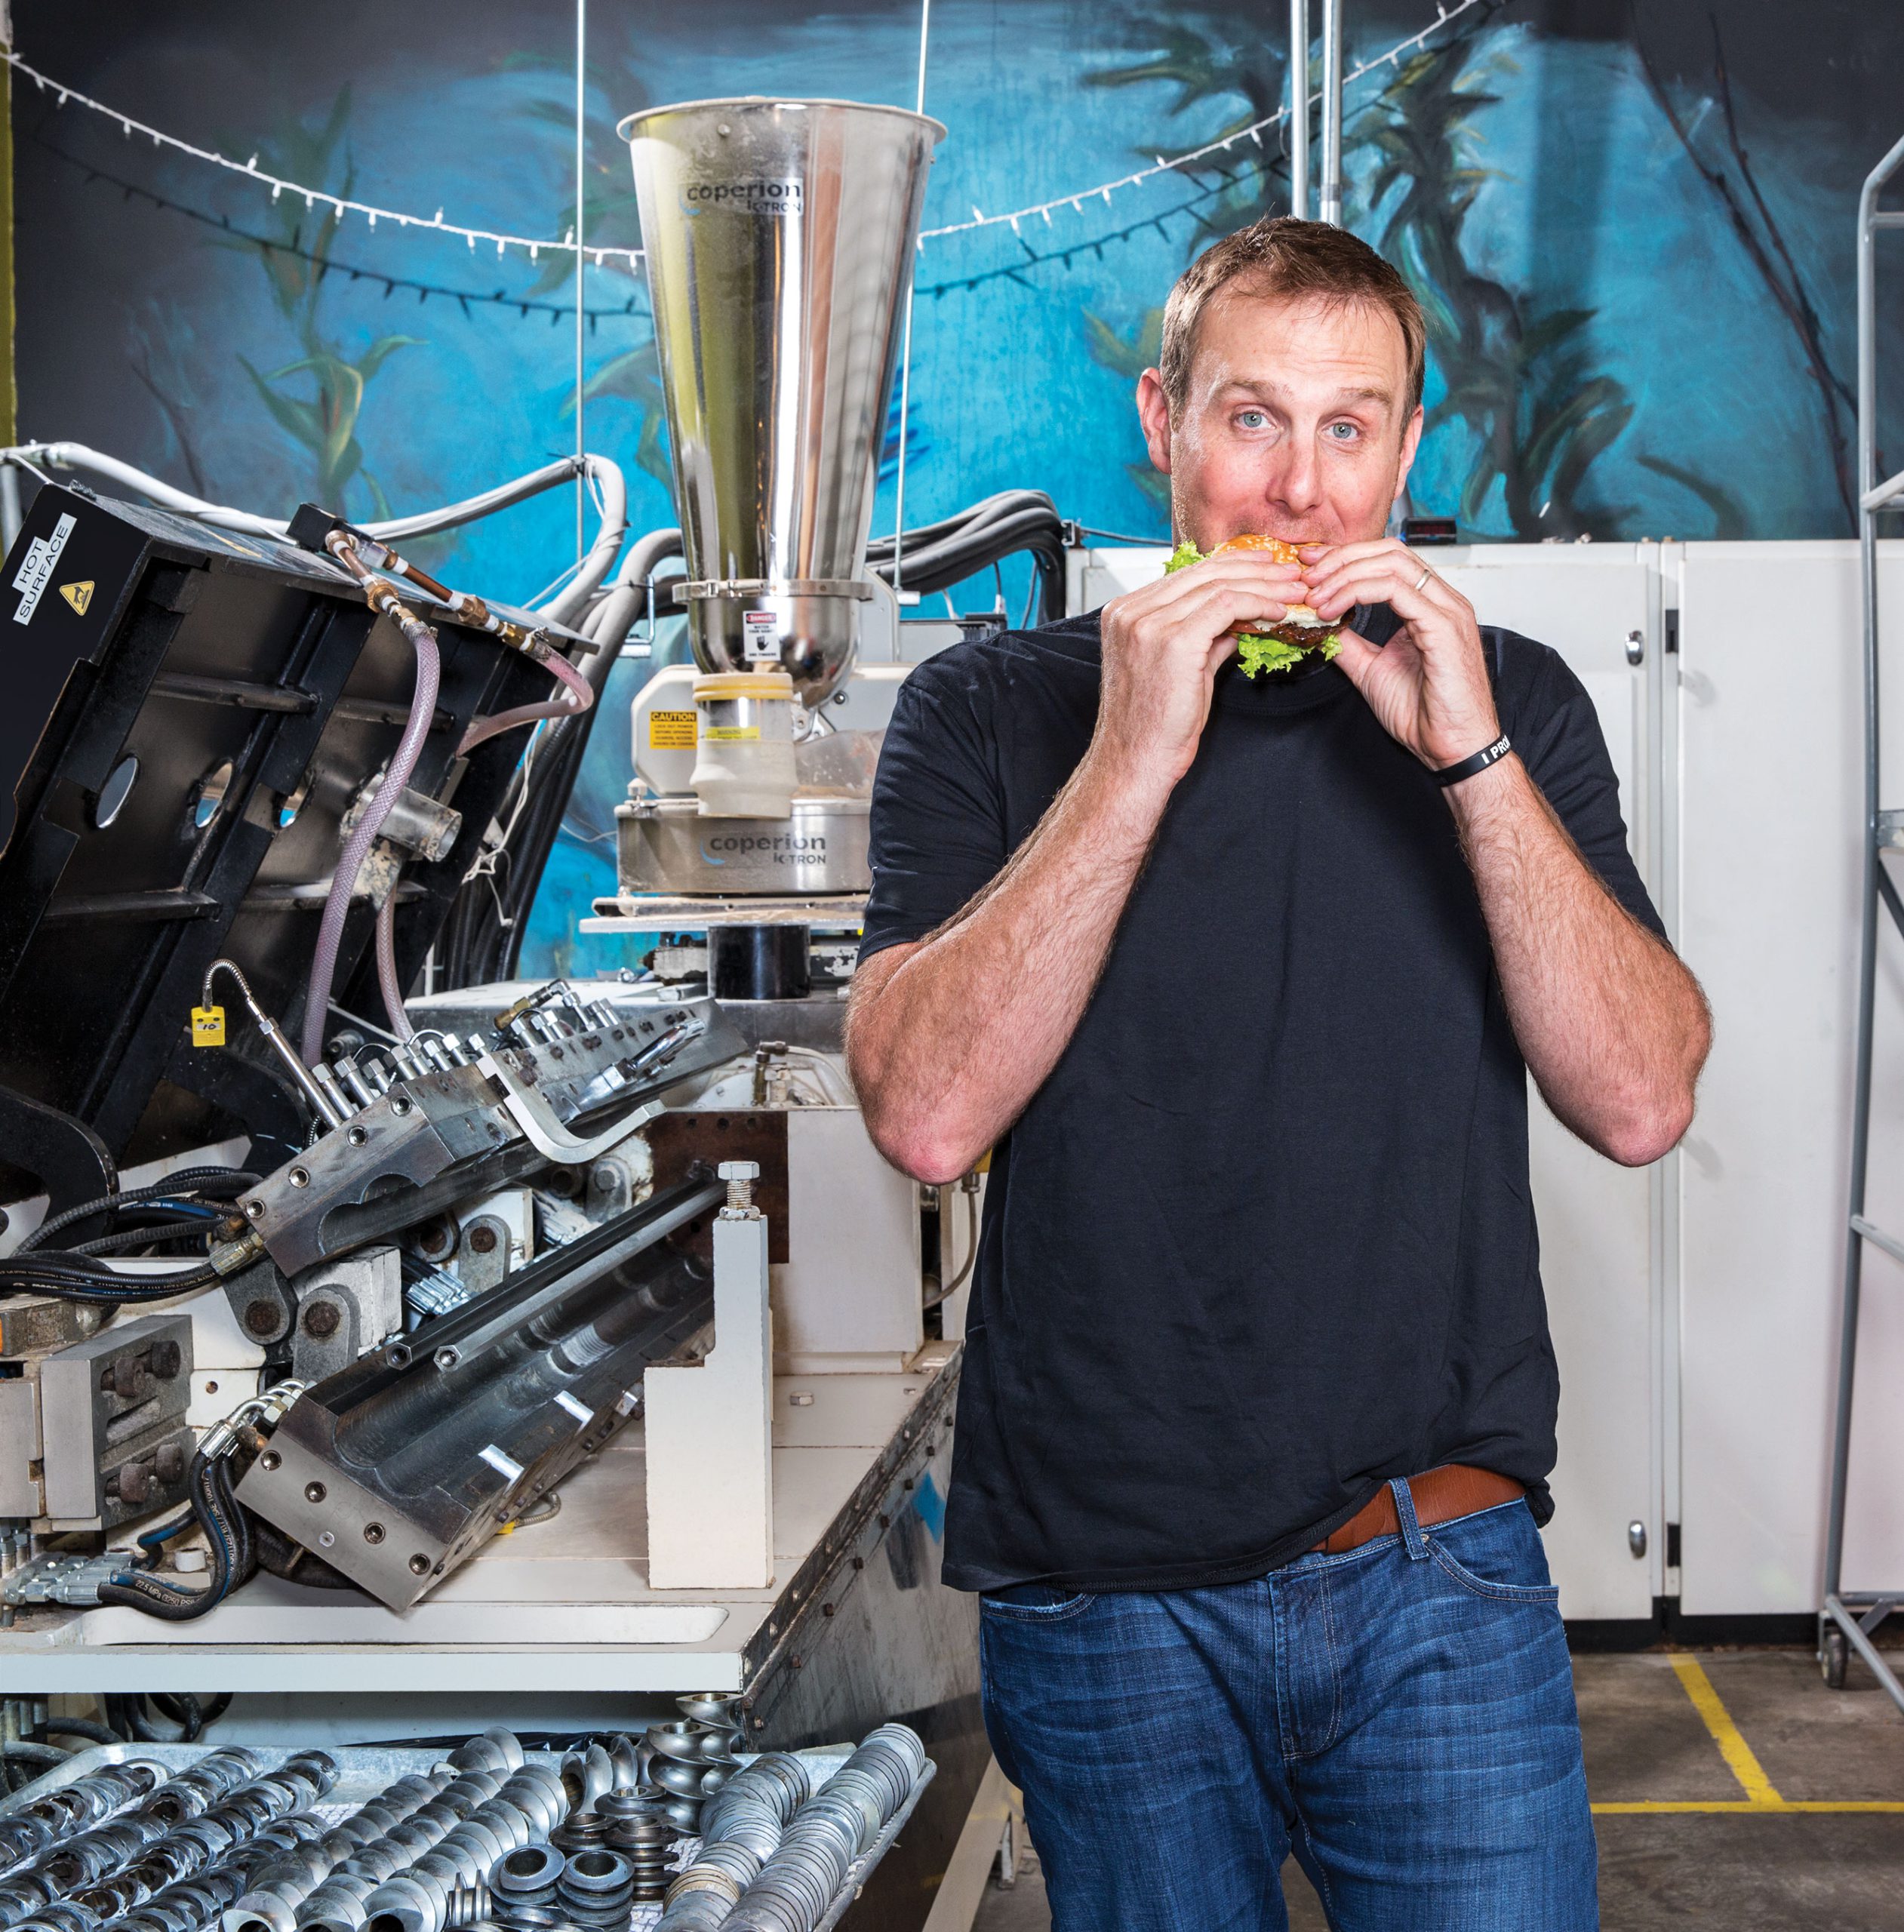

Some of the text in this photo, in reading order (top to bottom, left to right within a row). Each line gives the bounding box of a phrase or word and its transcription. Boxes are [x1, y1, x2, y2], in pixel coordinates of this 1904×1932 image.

[687, 180, 800, 202] coperion
[19, 541, 42, 583] HOT
[20, 525, 68, 617] SURFACE
[652, 712, 695, 721] CAUTION
[1481, 734, 1510, 764] I PRO
[709, 833, 826, 854] coperion
[148, 1586, 161, 1599] MPa
